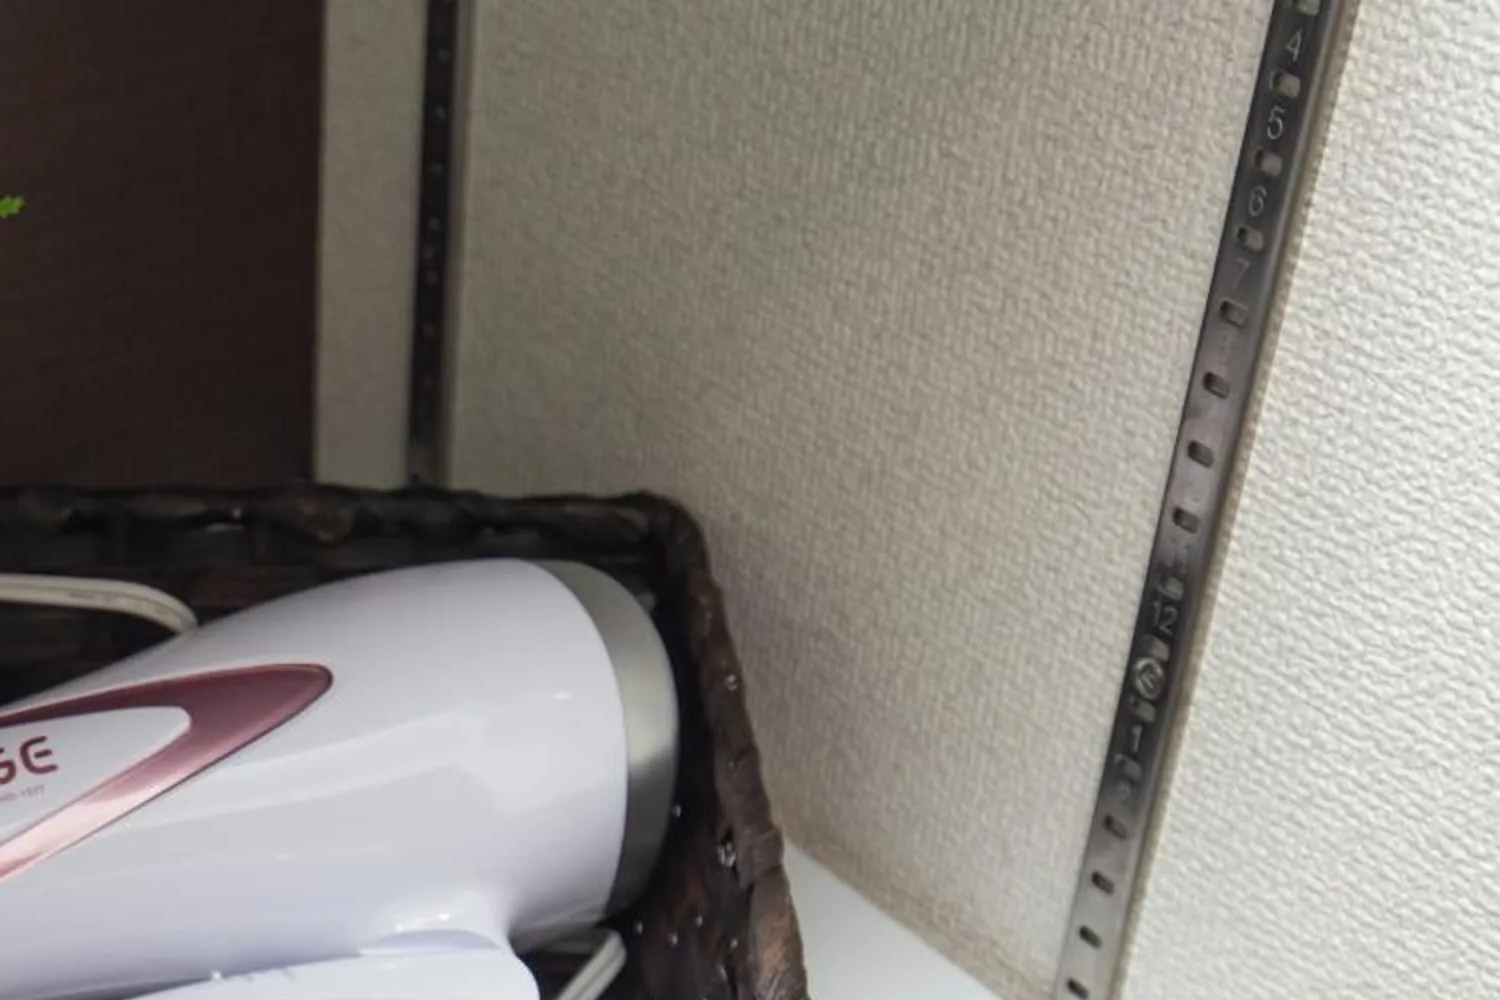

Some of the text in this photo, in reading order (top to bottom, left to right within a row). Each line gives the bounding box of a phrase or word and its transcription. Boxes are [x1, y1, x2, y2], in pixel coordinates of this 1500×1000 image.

[1286, 29, 1303, 61] 4
[1267, 105, 1285, 140] 5
[1249, 185, 1267, 217] 6
